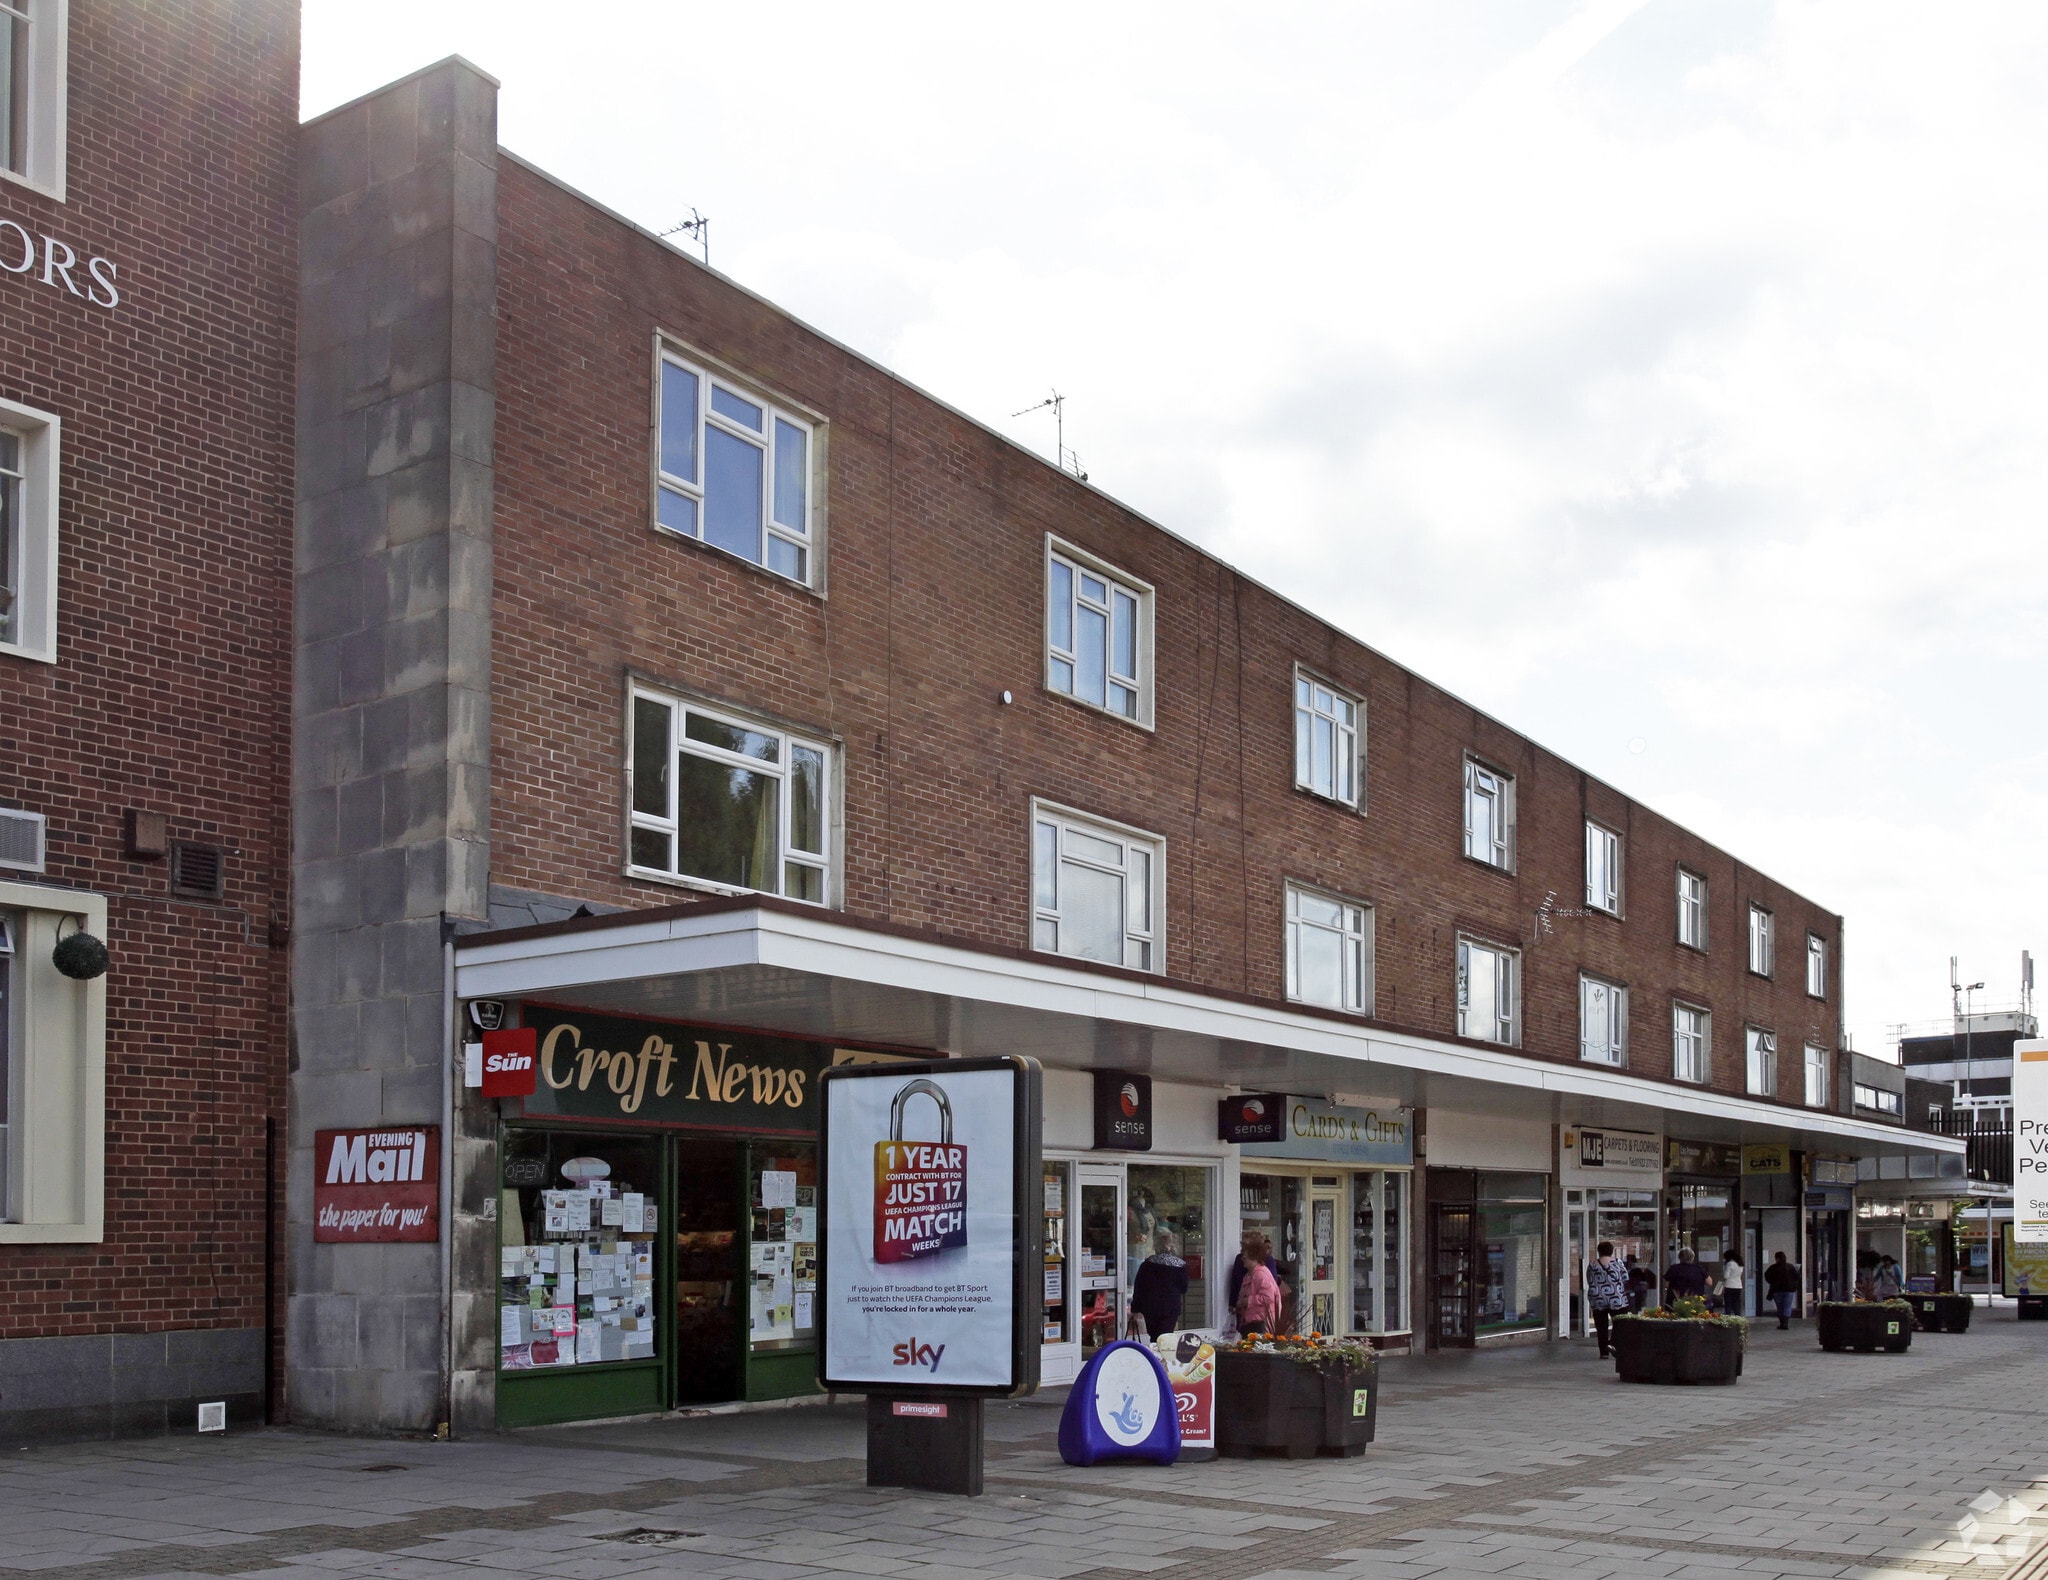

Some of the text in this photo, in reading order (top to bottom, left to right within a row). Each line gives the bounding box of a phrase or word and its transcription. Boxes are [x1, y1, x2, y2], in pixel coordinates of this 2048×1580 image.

[485, 1054, 532, 1073] Sun
[540, 1023, 806, 1113] Croft News
[1115, 1120, 1145, 1135] sense
[1234, 1123, 1272, 1134] sense
[1292, 1104, 1404, 1144] CARDS & GIFTS
[368, 1131, 413, 1148] EVENING
[1583, 1136, 1602, 1160] MJE
[1604, 1136, 1660, 1154] CARPETS & FLOORING
[325, 1131, 426, 1183] Mail
[885, 1145, 962, 1169] 1 YEAR
[1750, 1158, 1781, 1168] CATS
[505, 1164, 545, 1179] OPEN
[886, 1172, 921, 1181] CONTRACT
[922, 1172, 940, 1180] WITH
[885, 1180, 962, 1205] JUST 17
[319, 1202, 429, 1232] the paper for you!
[884, 1201, 963, 1216] UEFA CHAMPIONS LEAGUE
[884, 1211, 962, 1243] MATCH
[912, 1239, 941, 1252] WEEKS
[870, 1285, 883, 1293] join
[943, 1286, 956, 1294] get
[967, 1285, 988, 1293] Sport
[847, 1295, 861, 1304] just
[924, 1295, 963, 1303] Champions
[964, 1295, 993, 1304] League,
[862, 1305, 884, 1313] you're
[957, 1306, 977, 1314] year.
[893, 1336, 946, 1373] sky
[900, 1404, 940, 1415] primesight
